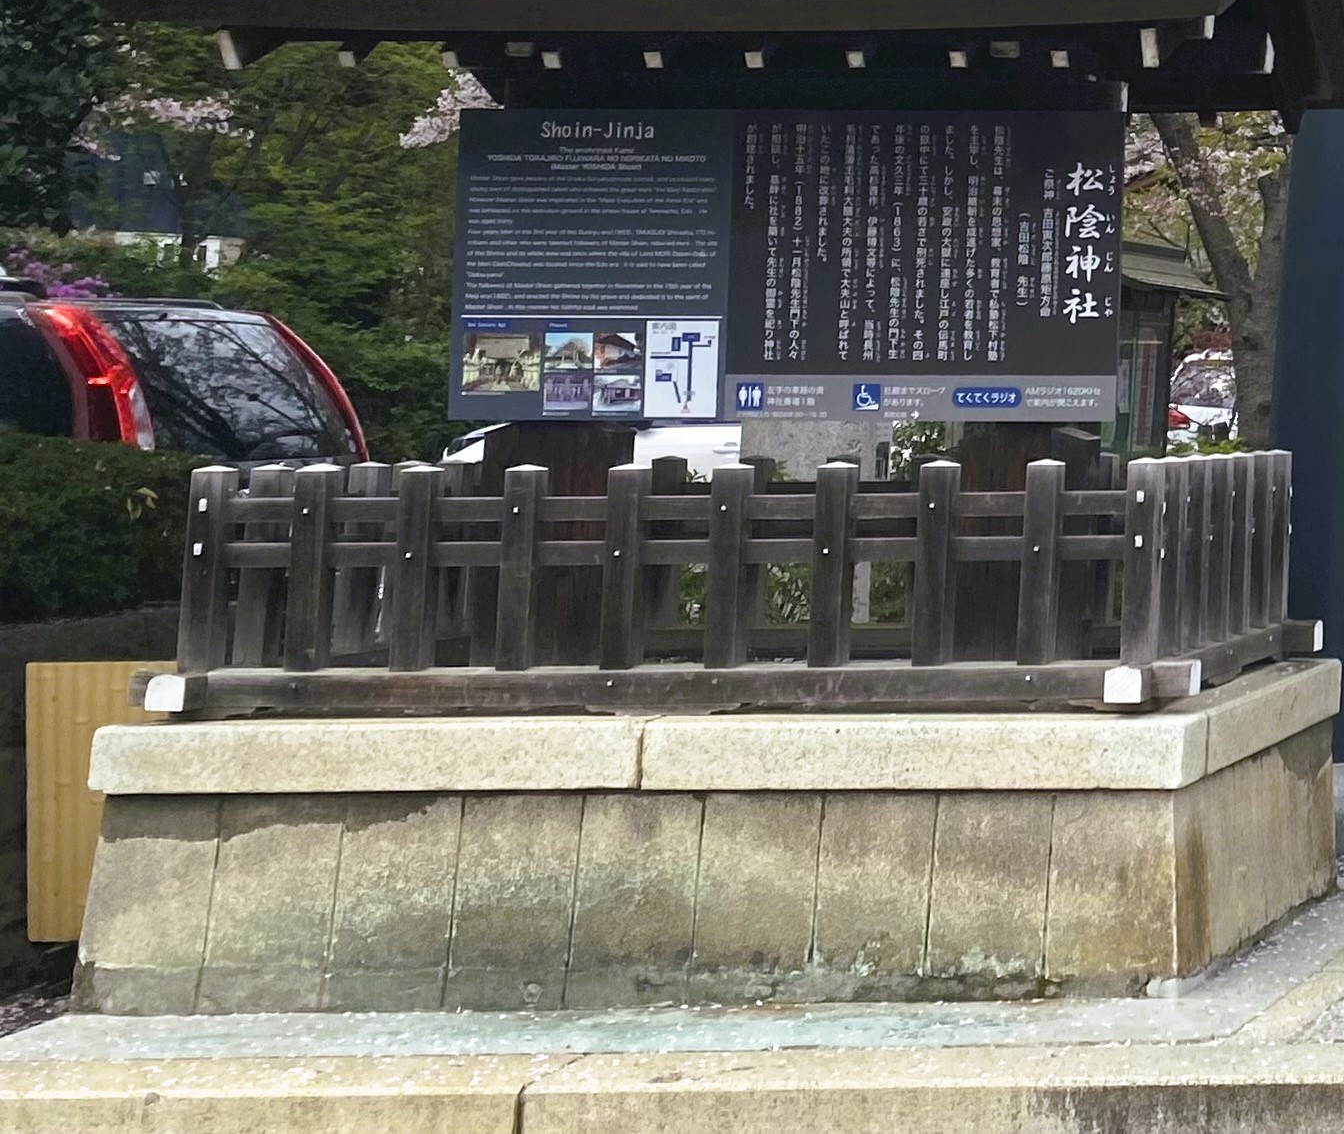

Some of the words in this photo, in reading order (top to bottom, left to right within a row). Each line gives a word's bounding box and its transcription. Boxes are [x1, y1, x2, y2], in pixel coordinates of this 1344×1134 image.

[540, 121, 655, 140] Shoin-Jinja
[1063, 162, 1105, 324] 松陰神社
[956, 392, 1016, 404] てくてくラジオ
